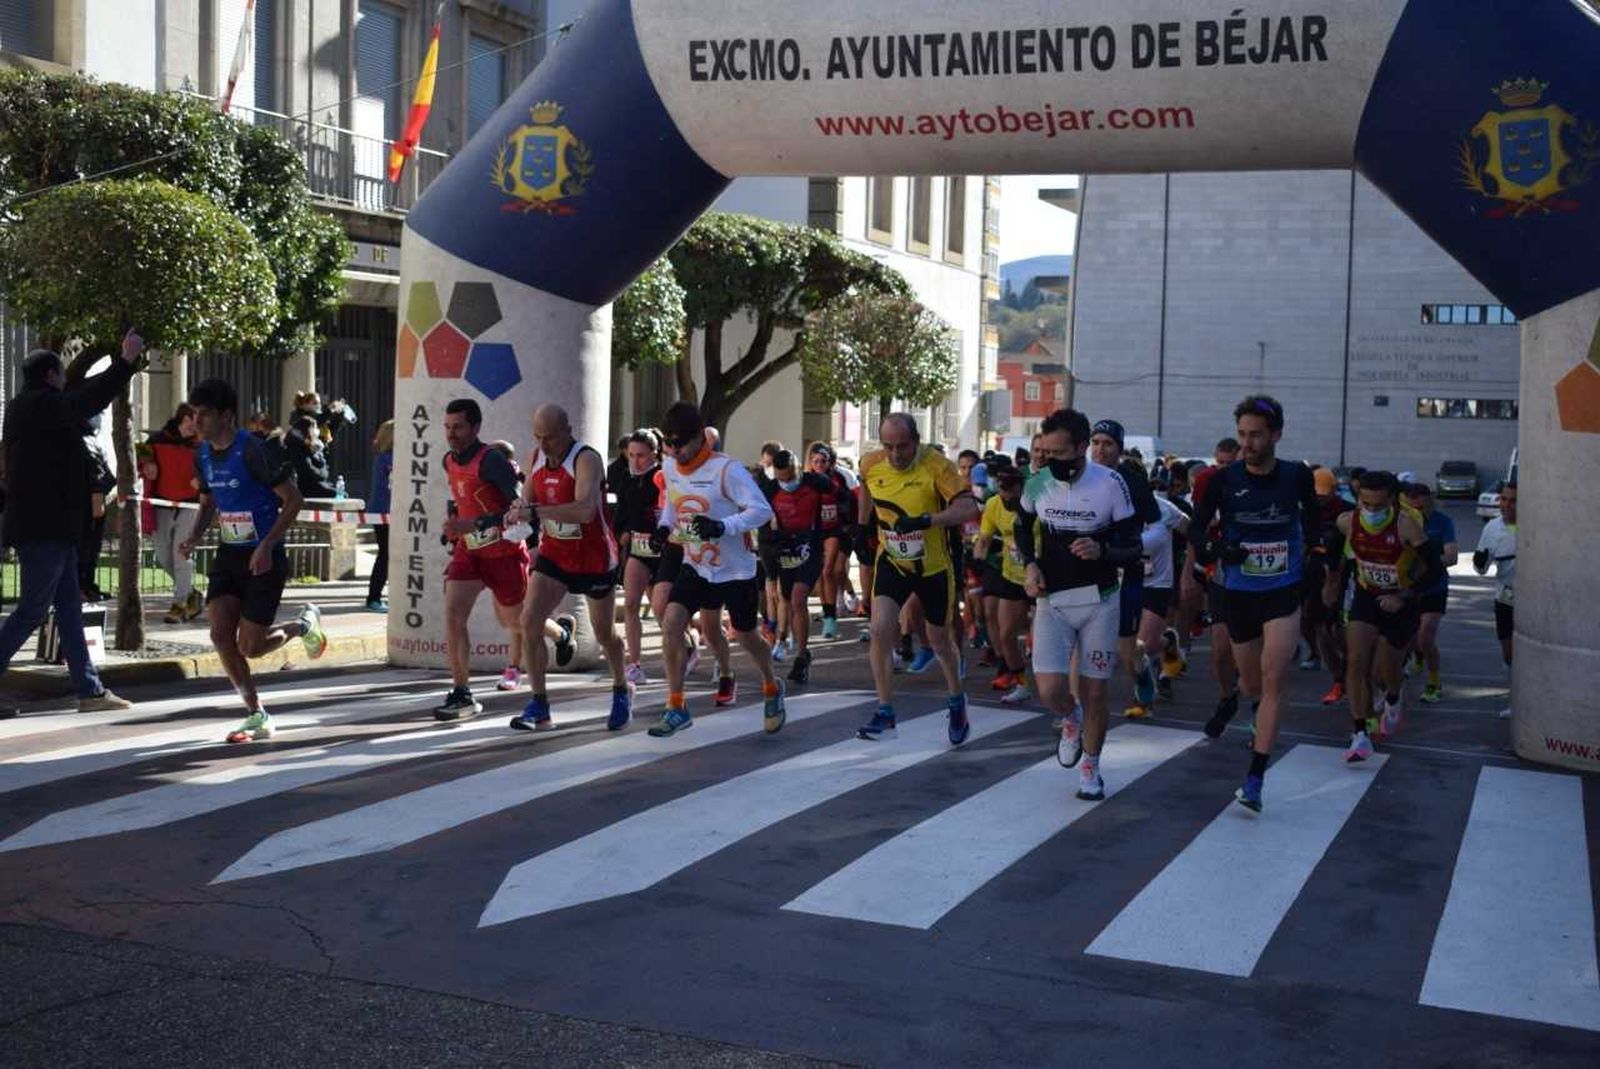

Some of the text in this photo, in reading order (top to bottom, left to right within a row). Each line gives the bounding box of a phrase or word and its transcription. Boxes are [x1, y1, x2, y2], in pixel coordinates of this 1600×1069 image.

[688, 8, 1328, 81] EXCMO. AYUNTAMIENTO DE BÉJAR
[815, 102, 1196, 141] www.aytobejar.com
[405, 404, 430, 629] AYUNTAMIENTO
[1255, 554, 1276, 569] 19
